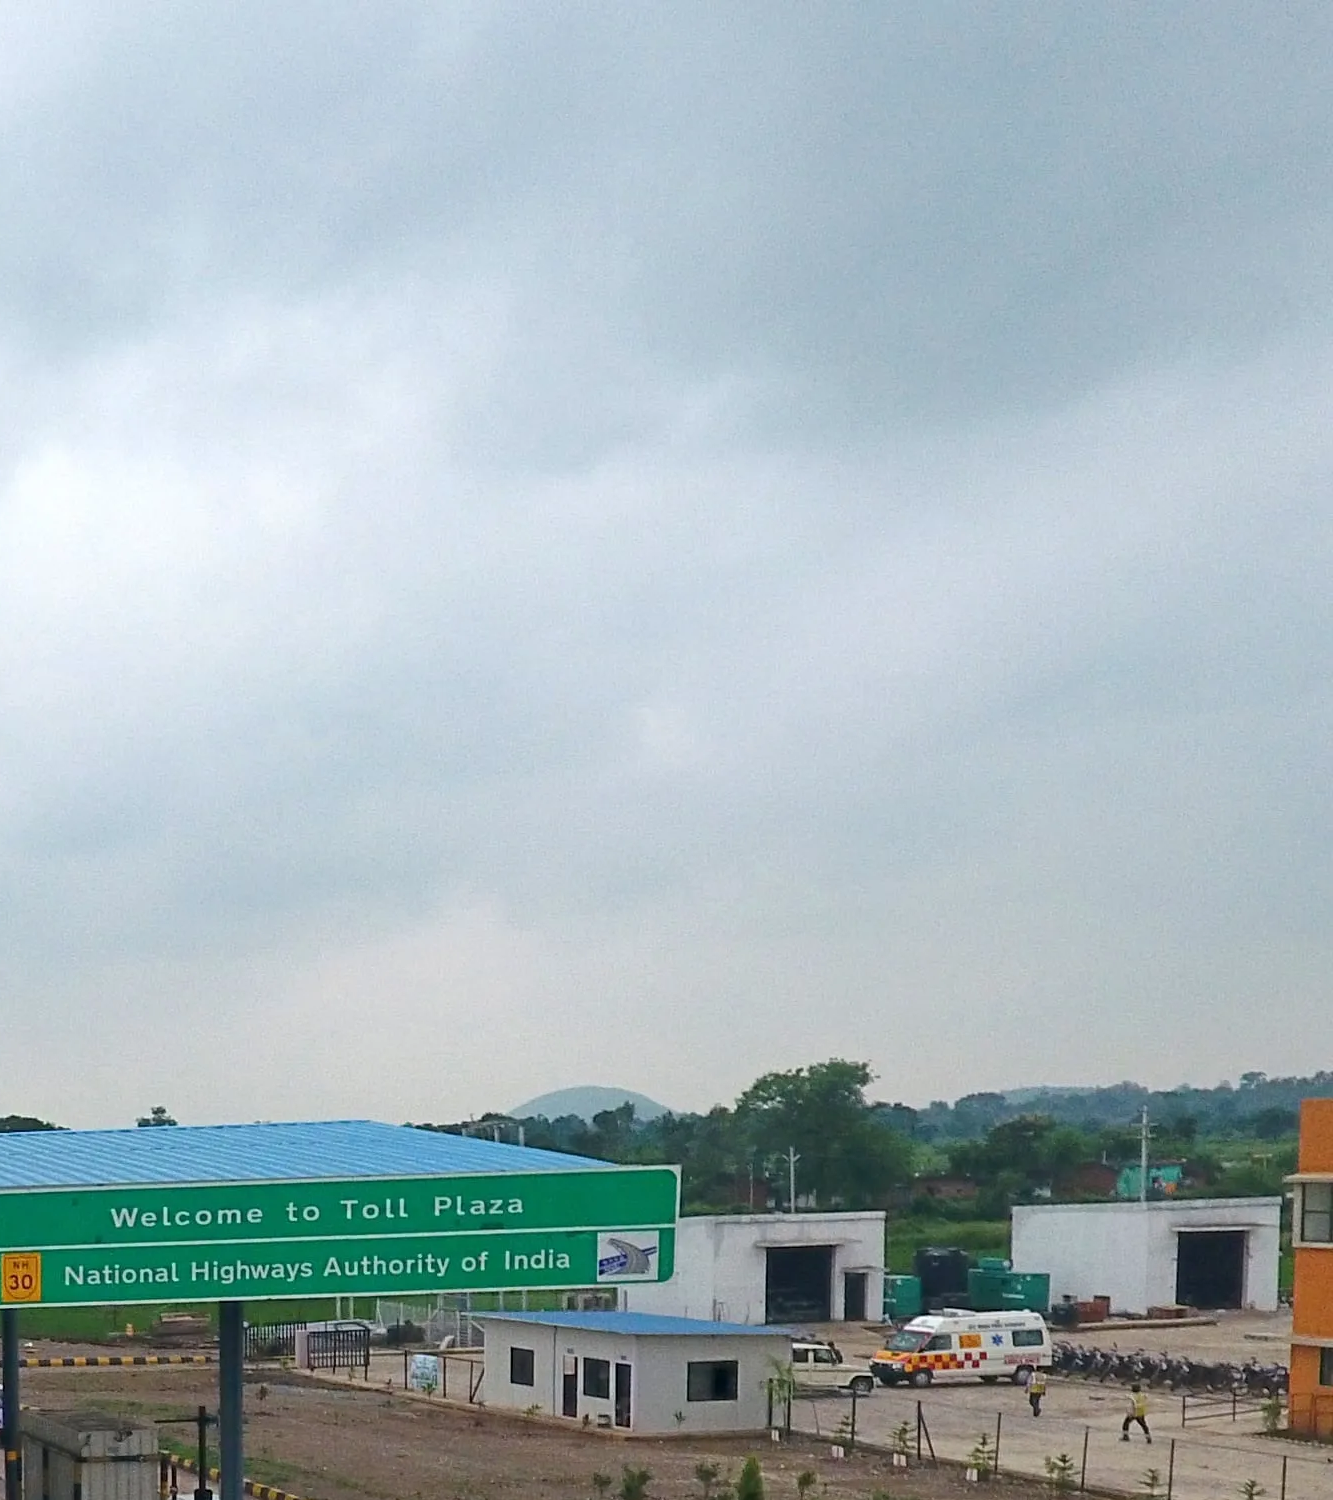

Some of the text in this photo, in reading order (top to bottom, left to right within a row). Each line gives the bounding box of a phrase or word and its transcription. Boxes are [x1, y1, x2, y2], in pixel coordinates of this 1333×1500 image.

[110, 1195, 524, 1228] Welcome to Toll Plaza
[8, 1273, 34, 1291] 30
[64, 1249, 571, 1286] National Highways Authority of India
